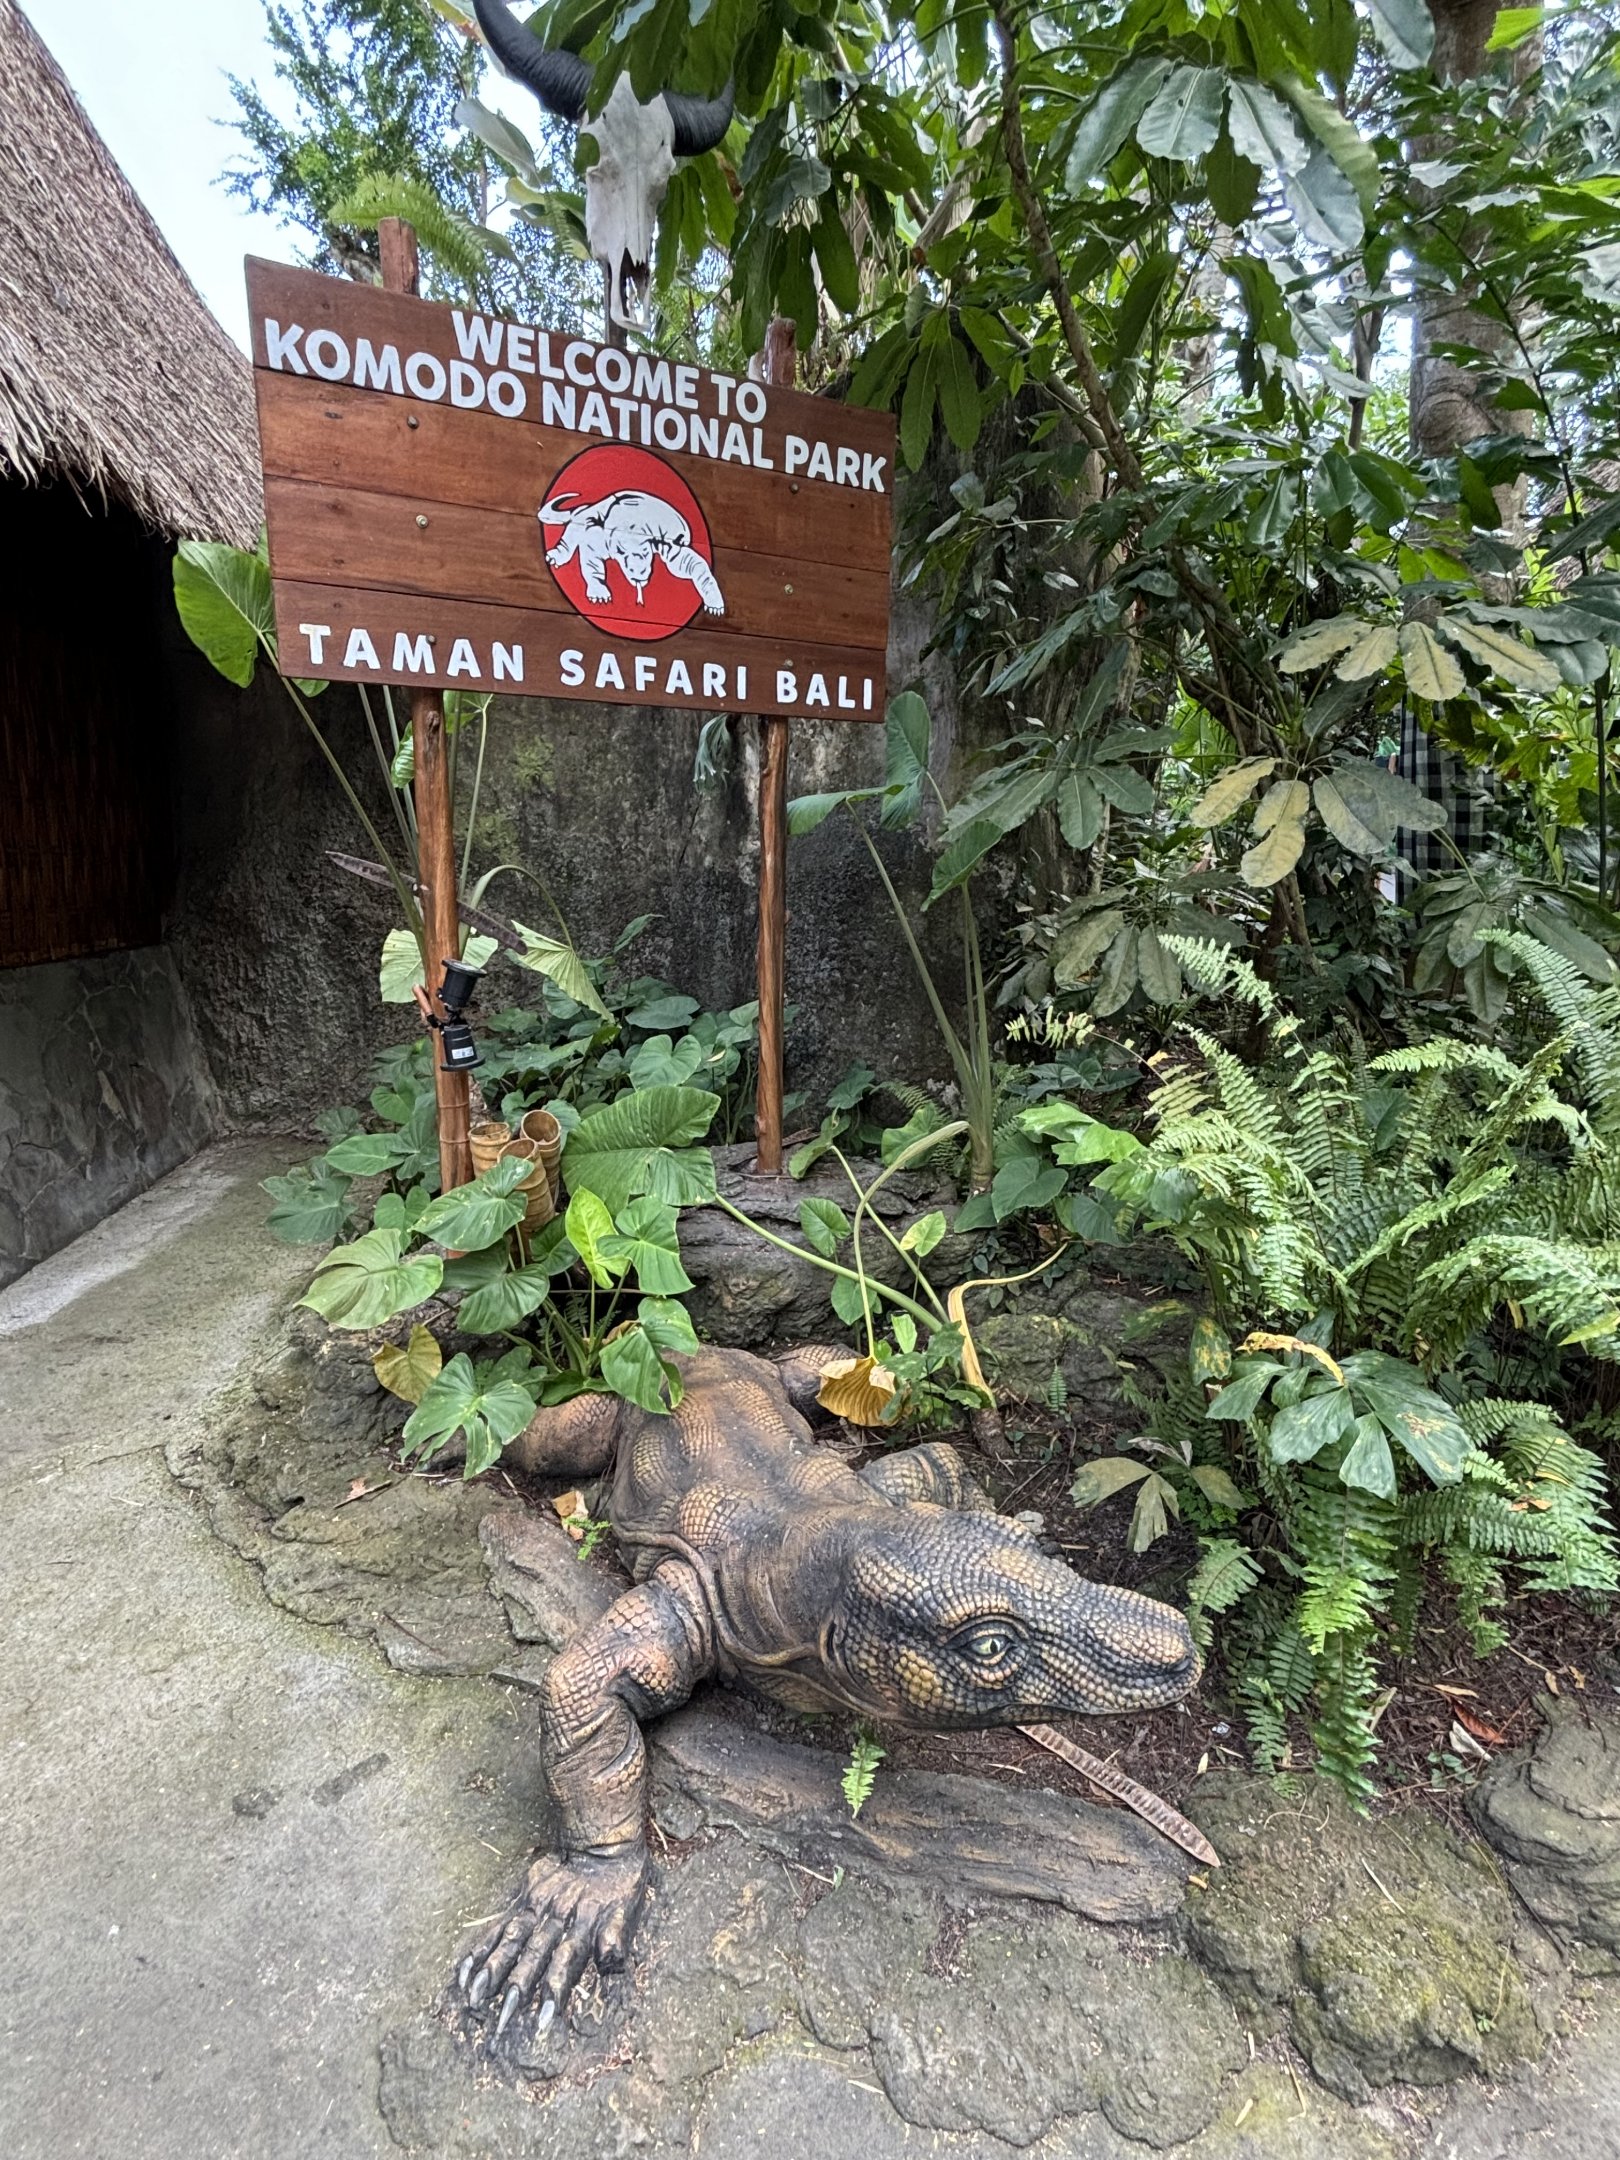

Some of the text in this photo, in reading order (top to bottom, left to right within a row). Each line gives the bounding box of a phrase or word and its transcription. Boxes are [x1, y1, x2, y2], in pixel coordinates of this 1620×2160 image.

[264, 318, 888, 493] KOMODO NATIONAL PARK
[451, 309, 767, 425] WELCOME TO
[299, 623, 873, 710] TAMAN SAFARI BALI
